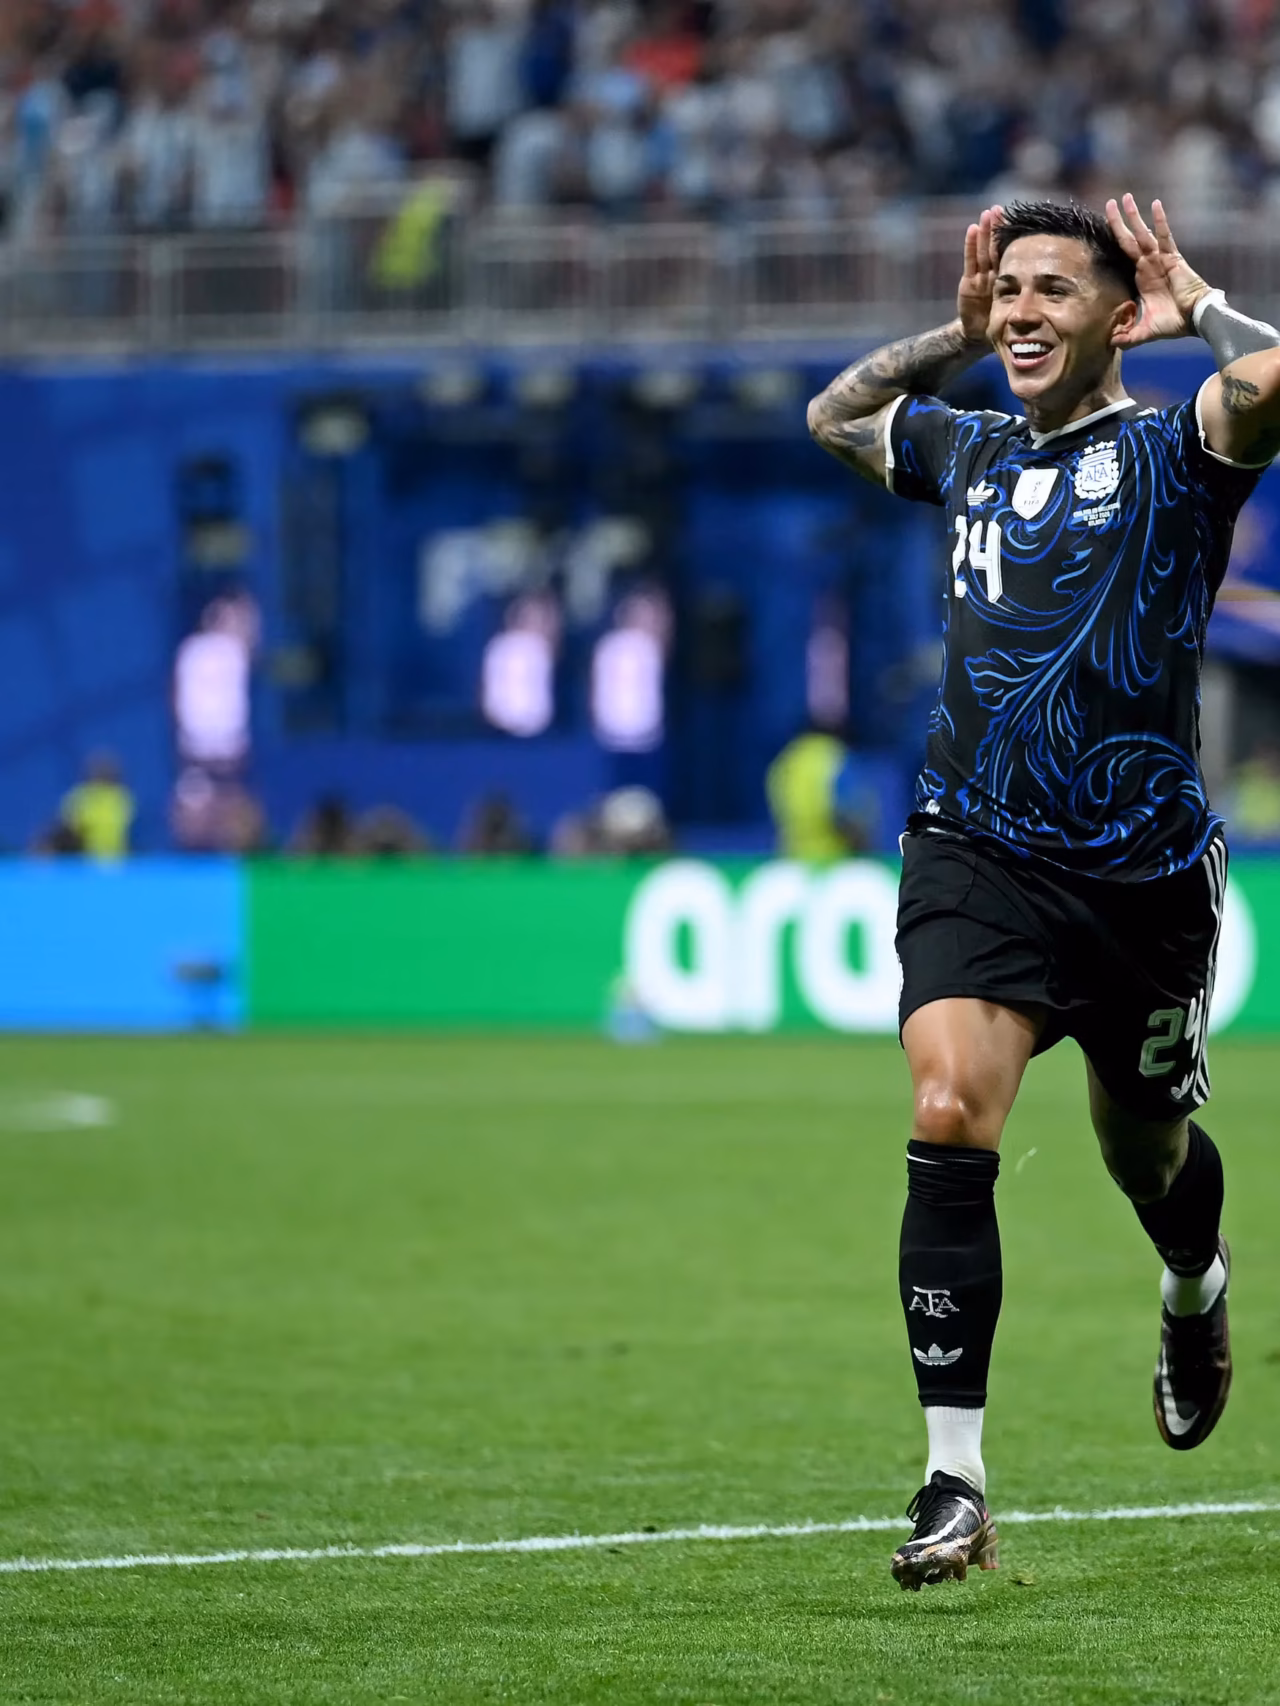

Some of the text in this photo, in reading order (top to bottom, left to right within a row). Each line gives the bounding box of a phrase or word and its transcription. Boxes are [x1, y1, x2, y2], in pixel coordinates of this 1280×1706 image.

[1084, 462, 1109, 483] AFA
[1138, 987, 1205, 1078] 24
[909, 1286, 960, 1318] AFA
